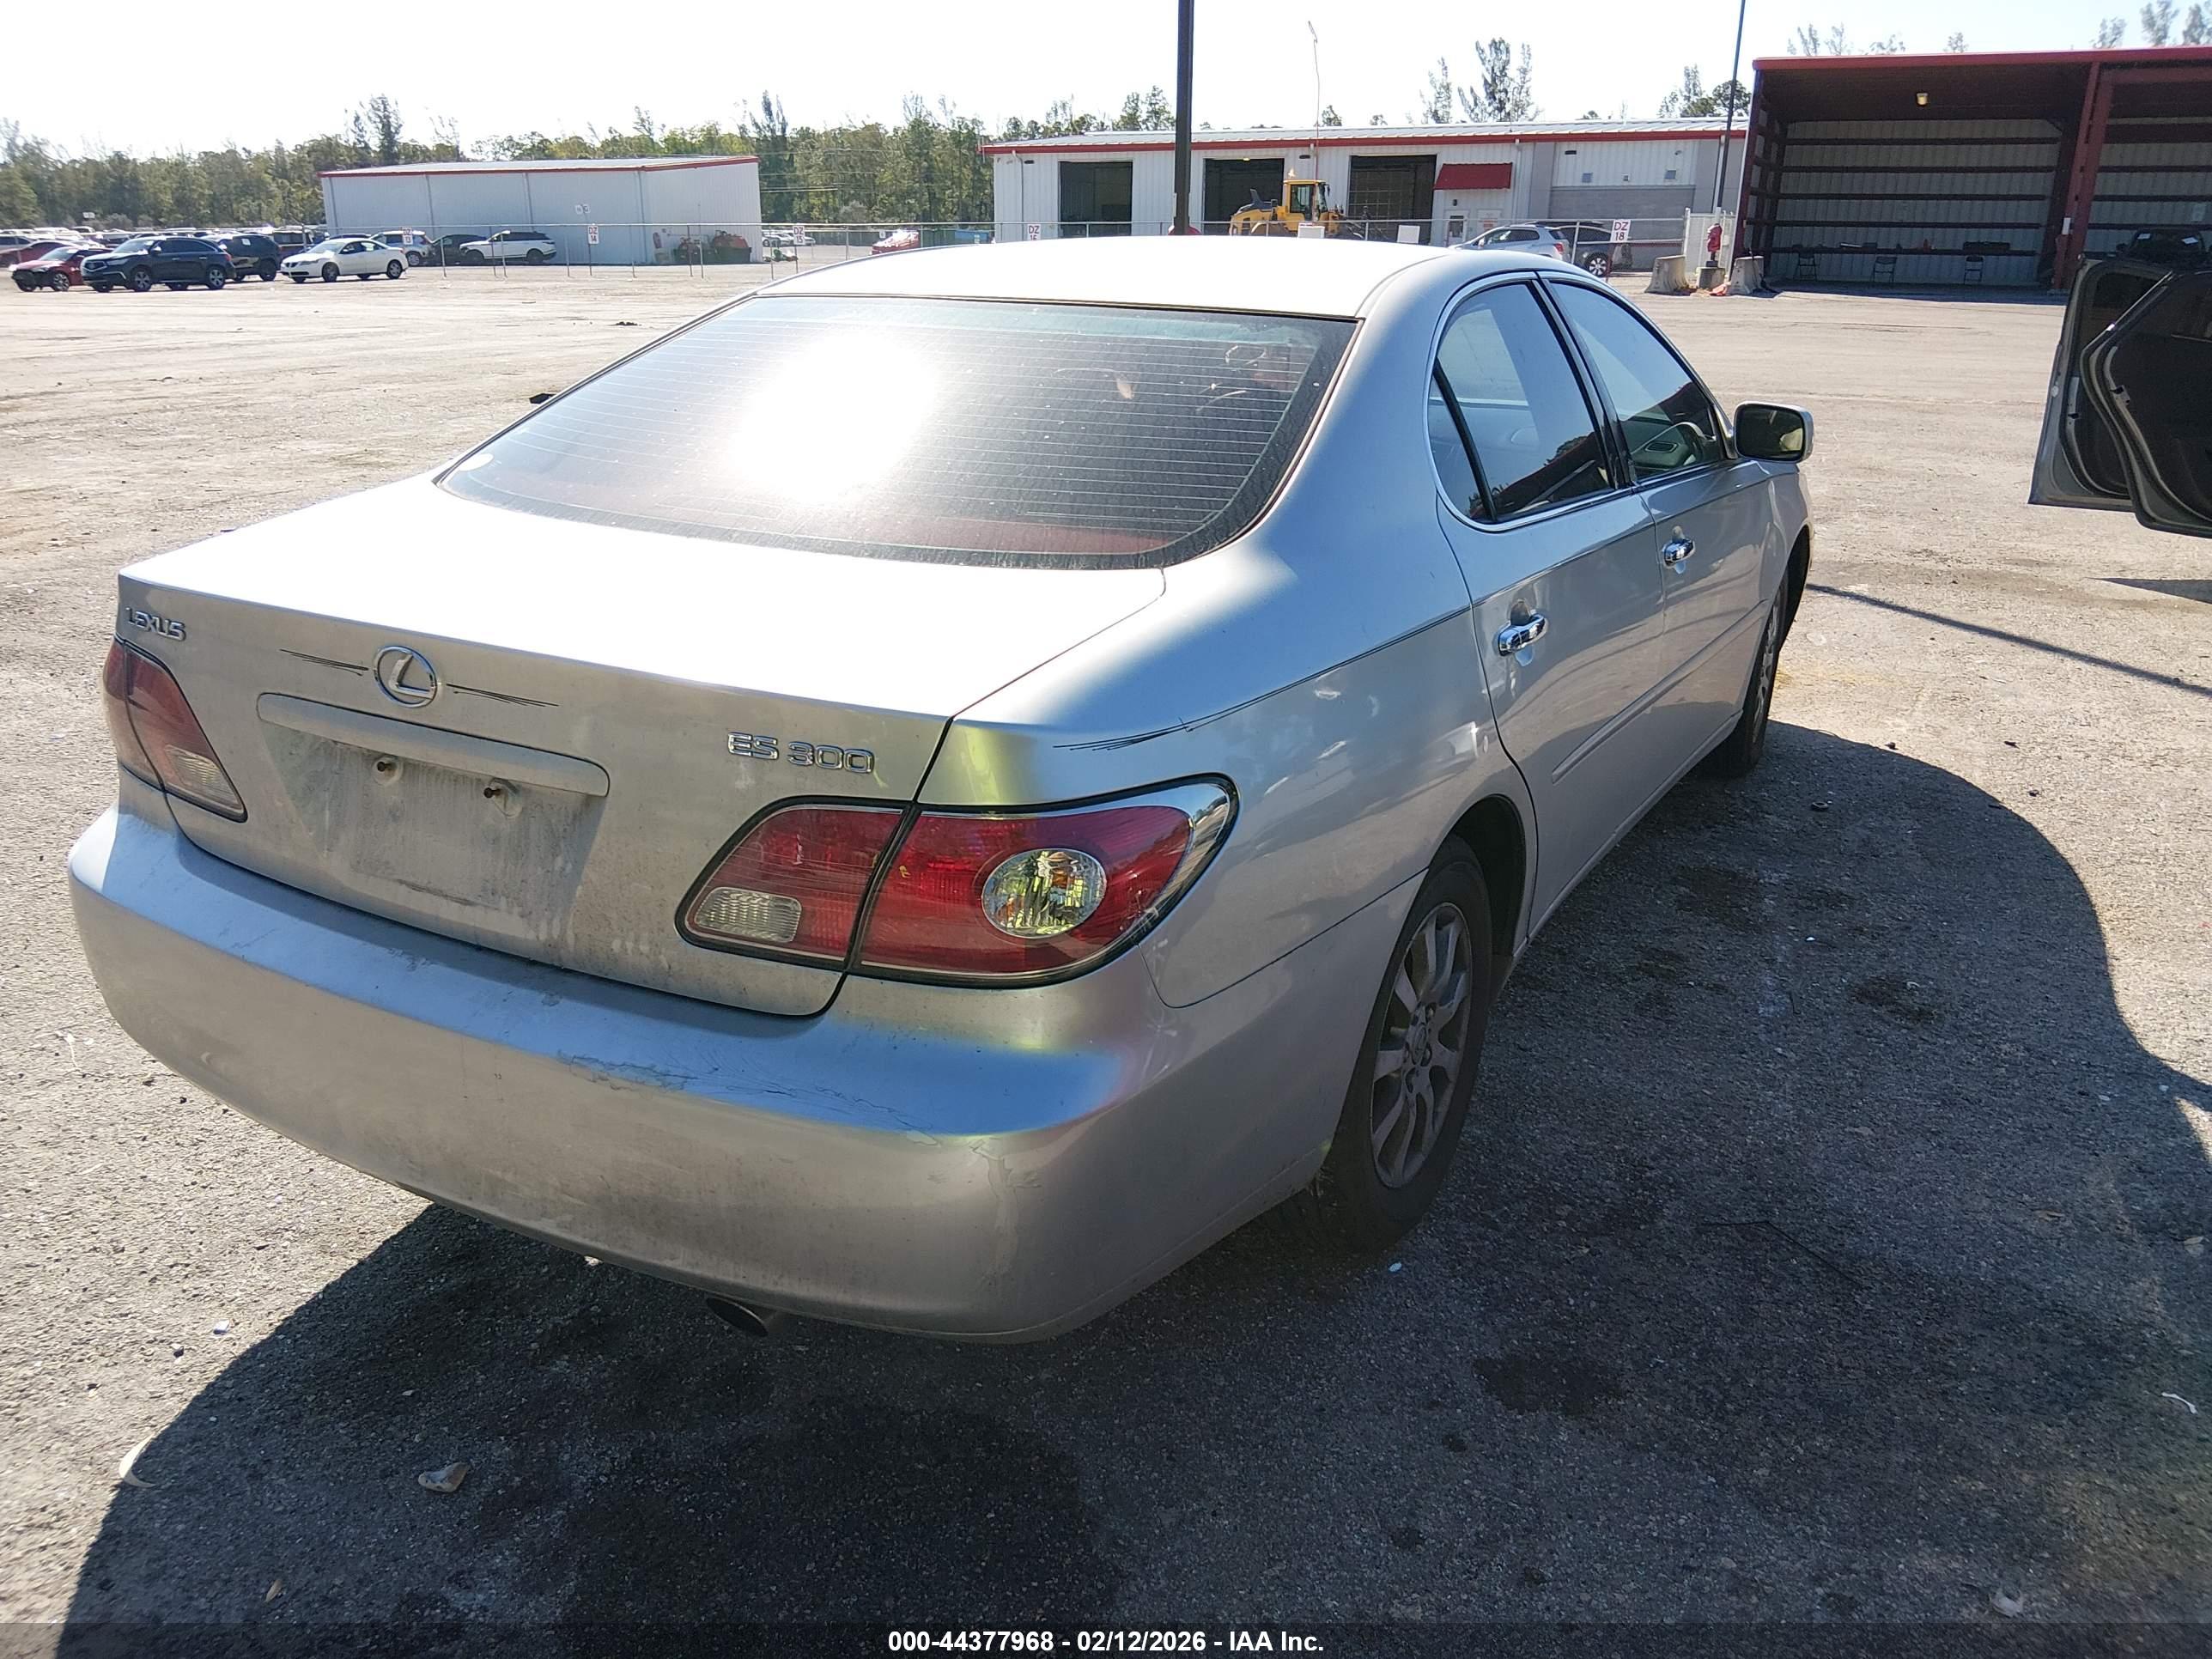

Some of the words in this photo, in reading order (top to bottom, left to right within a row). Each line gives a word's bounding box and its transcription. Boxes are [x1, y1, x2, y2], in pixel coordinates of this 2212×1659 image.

[1028, 225, 1040, 234] DZ
[1614, 222, 1629, 231] DZ
[1615, 232, 1625, 241] 18
[125, 607, 186, 641] LEXUS
[727, 732, 779, 760] ES
[787, 741, 875, 774] 300
